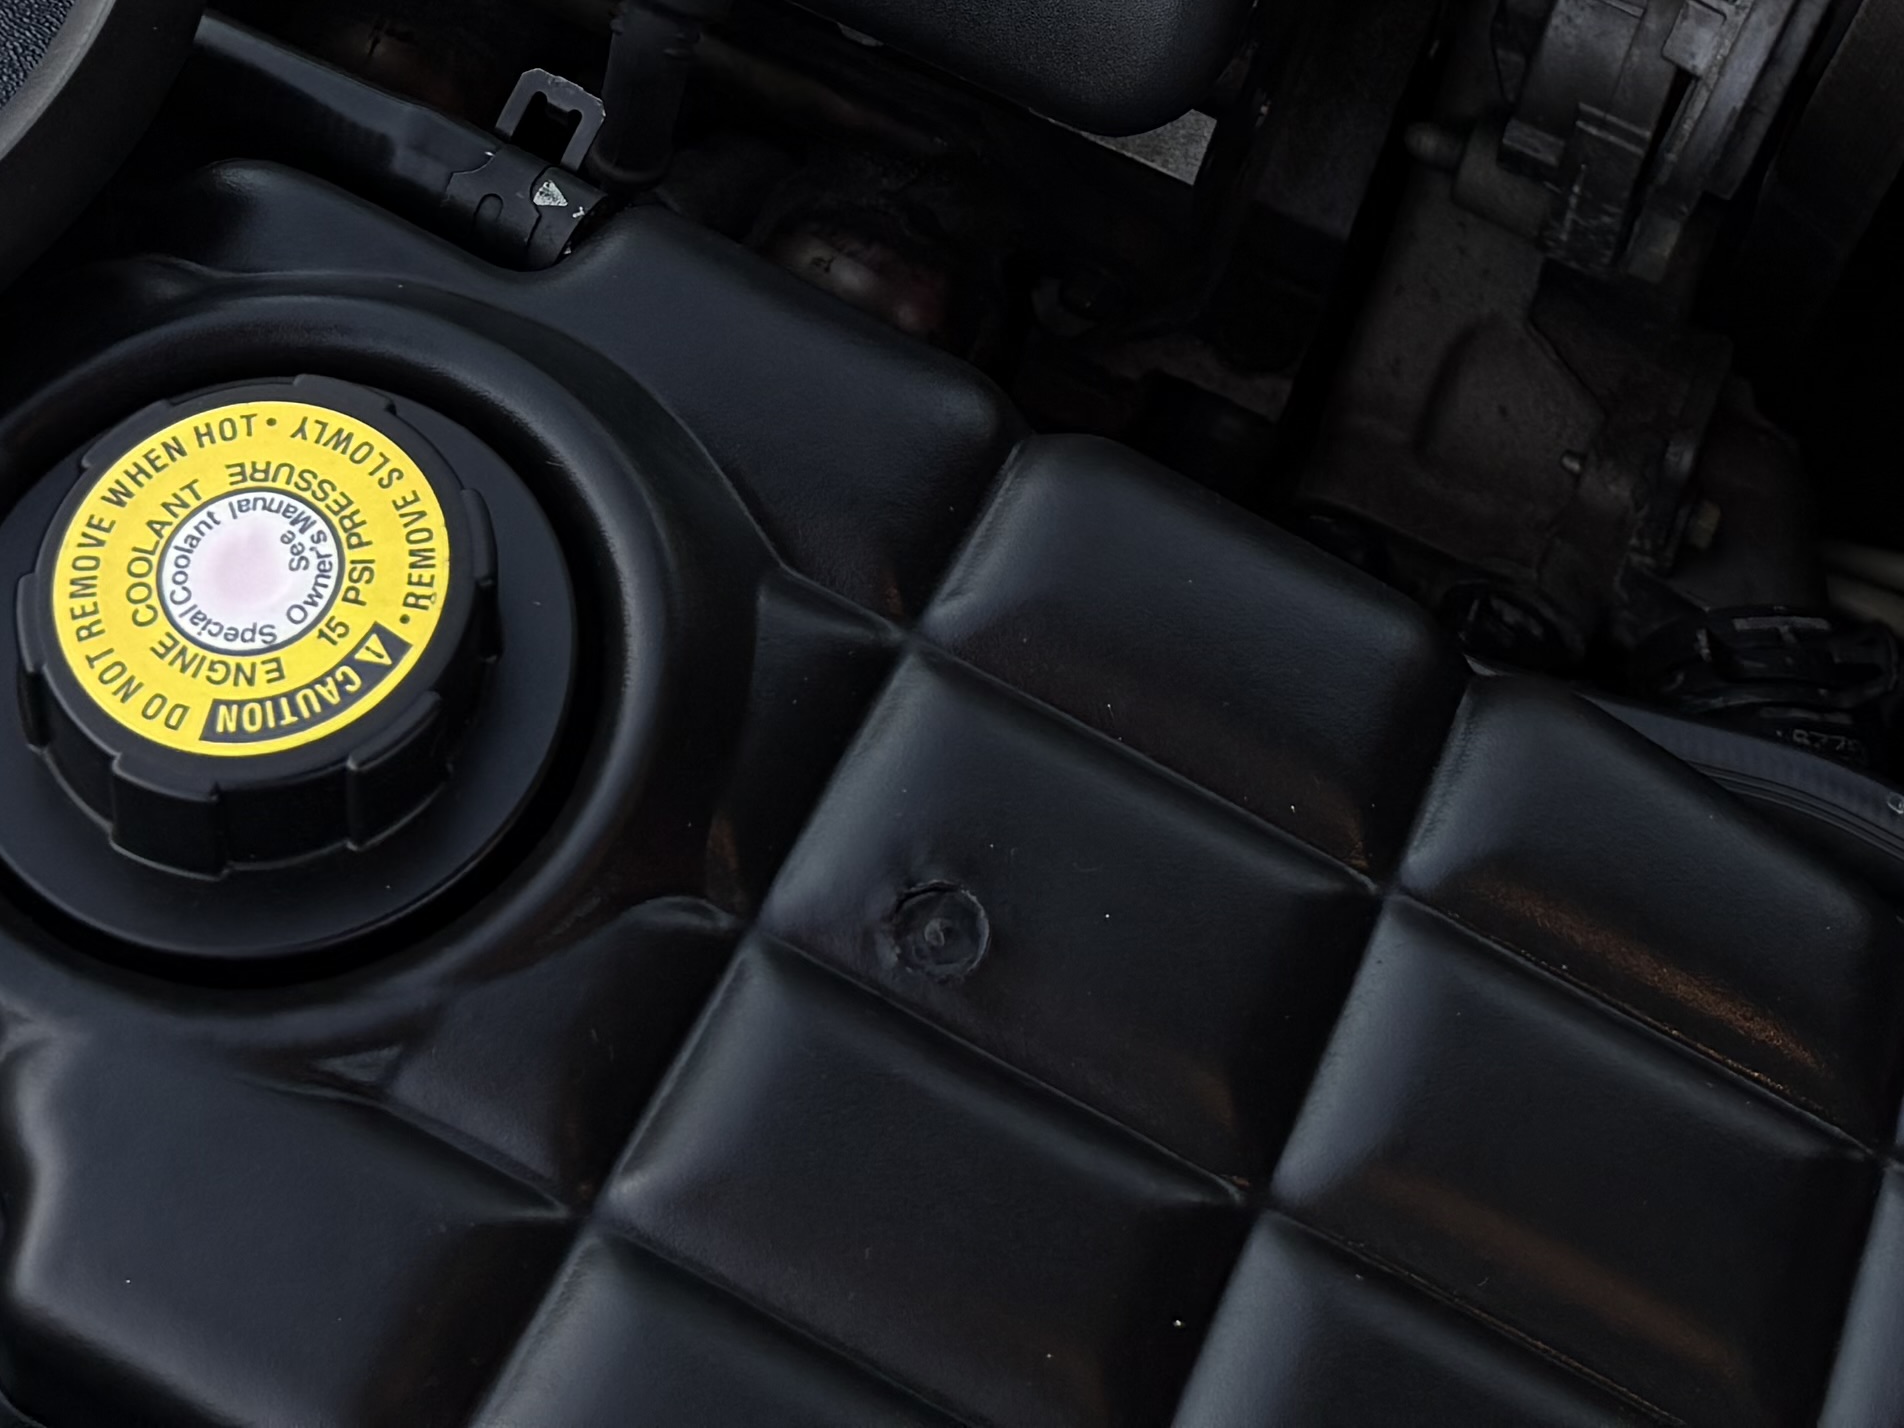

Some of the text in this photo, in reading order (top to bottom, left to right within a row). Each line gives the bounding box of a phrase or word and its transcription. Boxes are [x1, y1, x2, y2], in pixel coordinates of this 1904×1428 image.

[69, 412, 259, 732] DO NOT REMOVE WHEN HOT
[125, 477, 287, 687] ENGINE COOLANT
[169, 510, 278, 645] Special Coolant
[224, 460, 376, 647] 15 PSI PRESSURE
[227, 496, 334, 626] Owner's Manual
[280, 529, 311, 573] See
[289, 415, 437, 611] REMOVE SLOWLY
[215, 665, 363, 734] CAUTION
